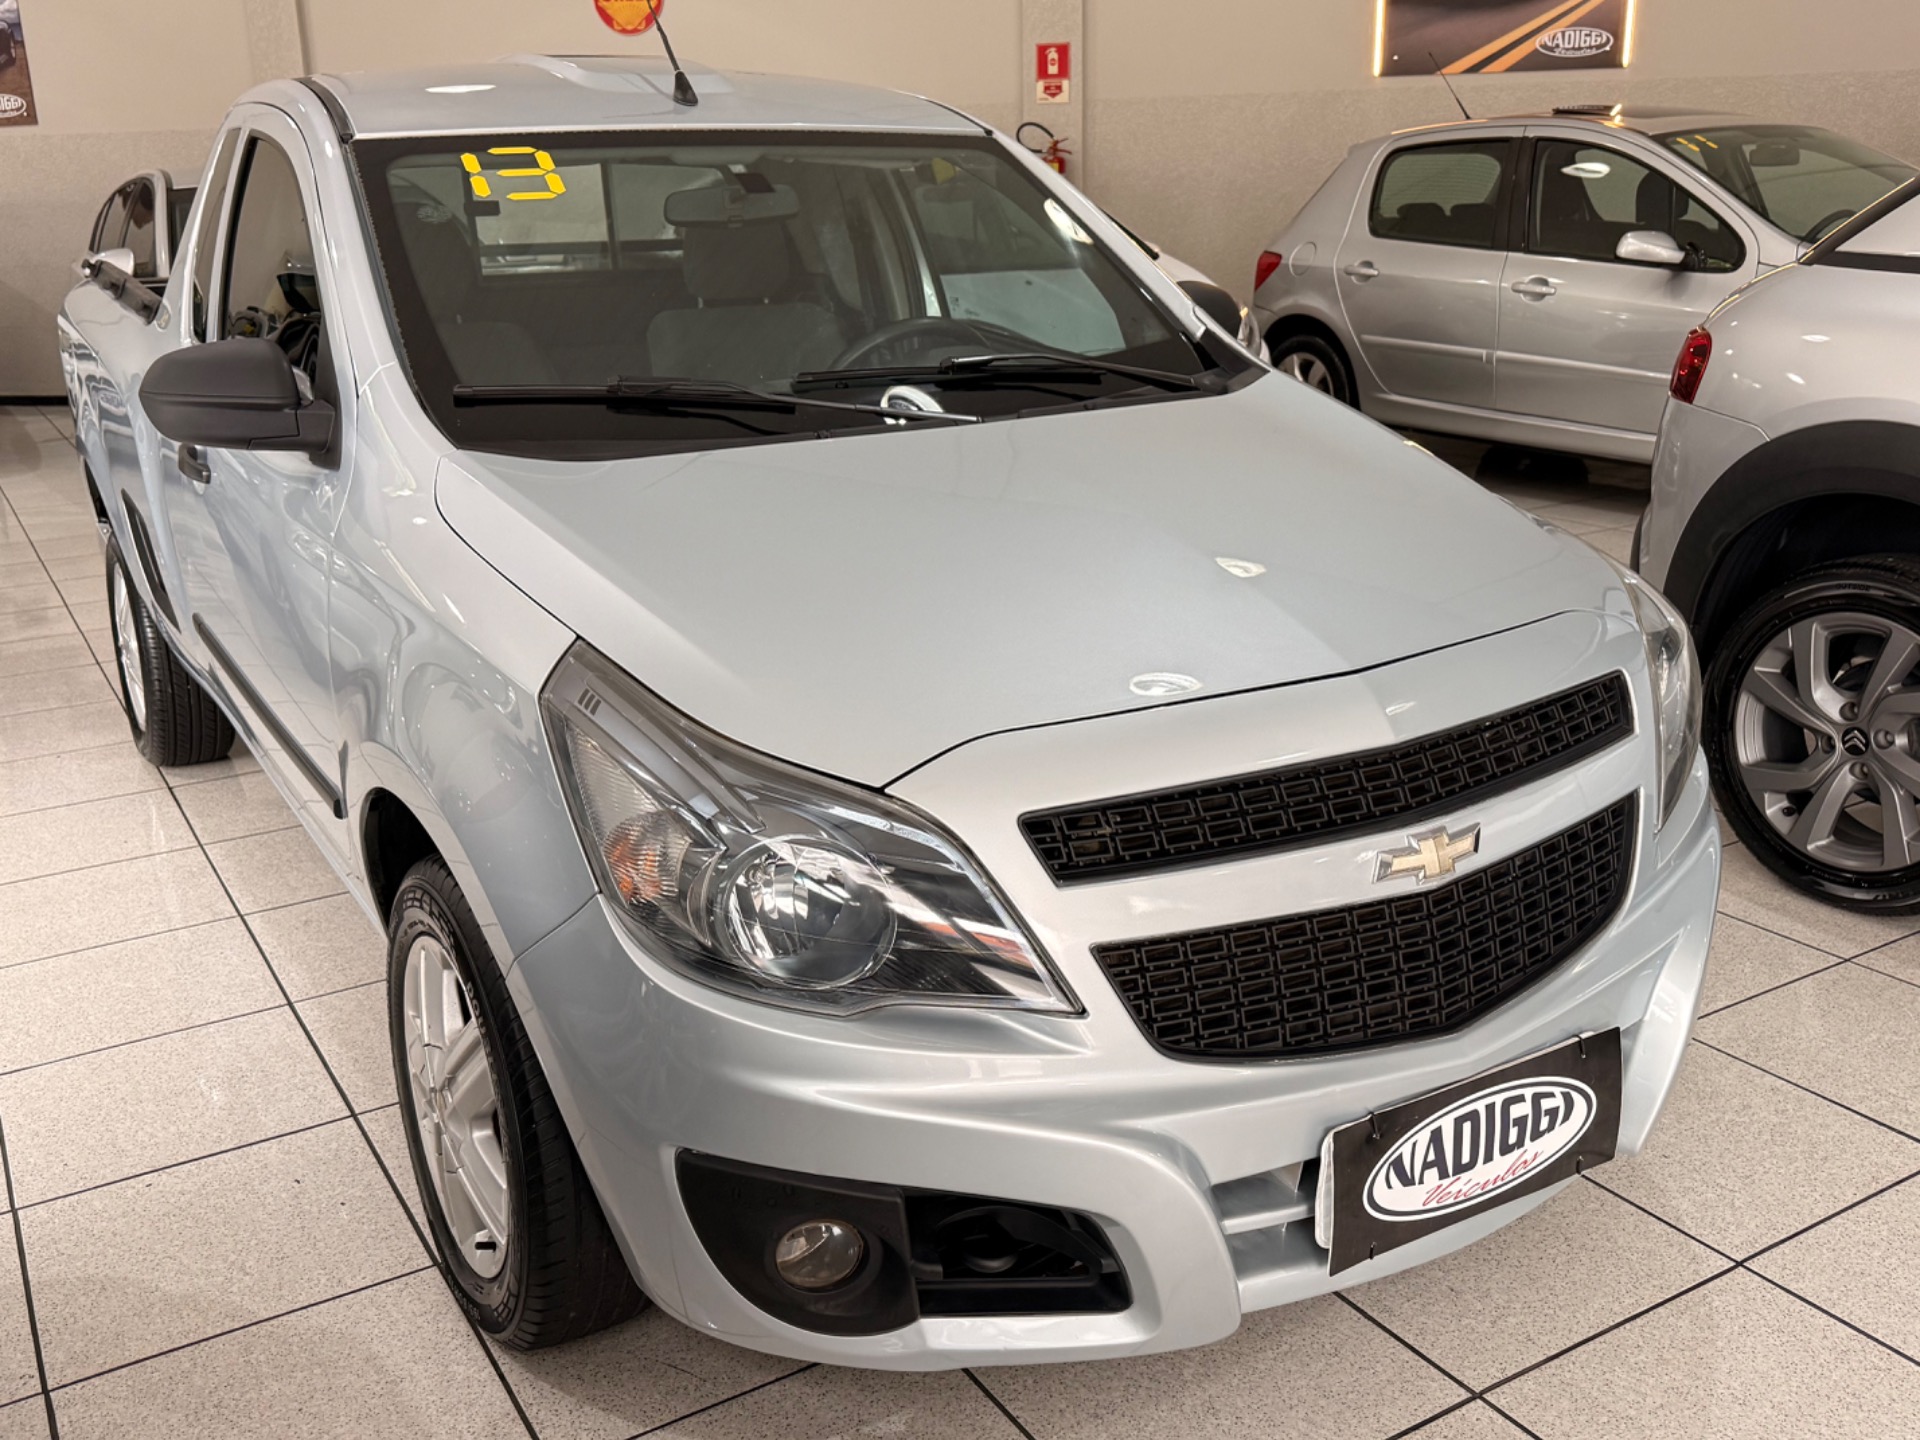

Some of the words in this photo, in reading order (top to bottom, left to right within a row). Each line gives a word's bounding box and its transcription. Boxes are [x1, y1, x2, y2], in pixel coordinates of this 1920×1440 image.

[1541, 30, 1608, 48] NADIGGI
[460, 146, 567, 201] 13
[1384, 1090, 1575, 1189] NADIGGI
